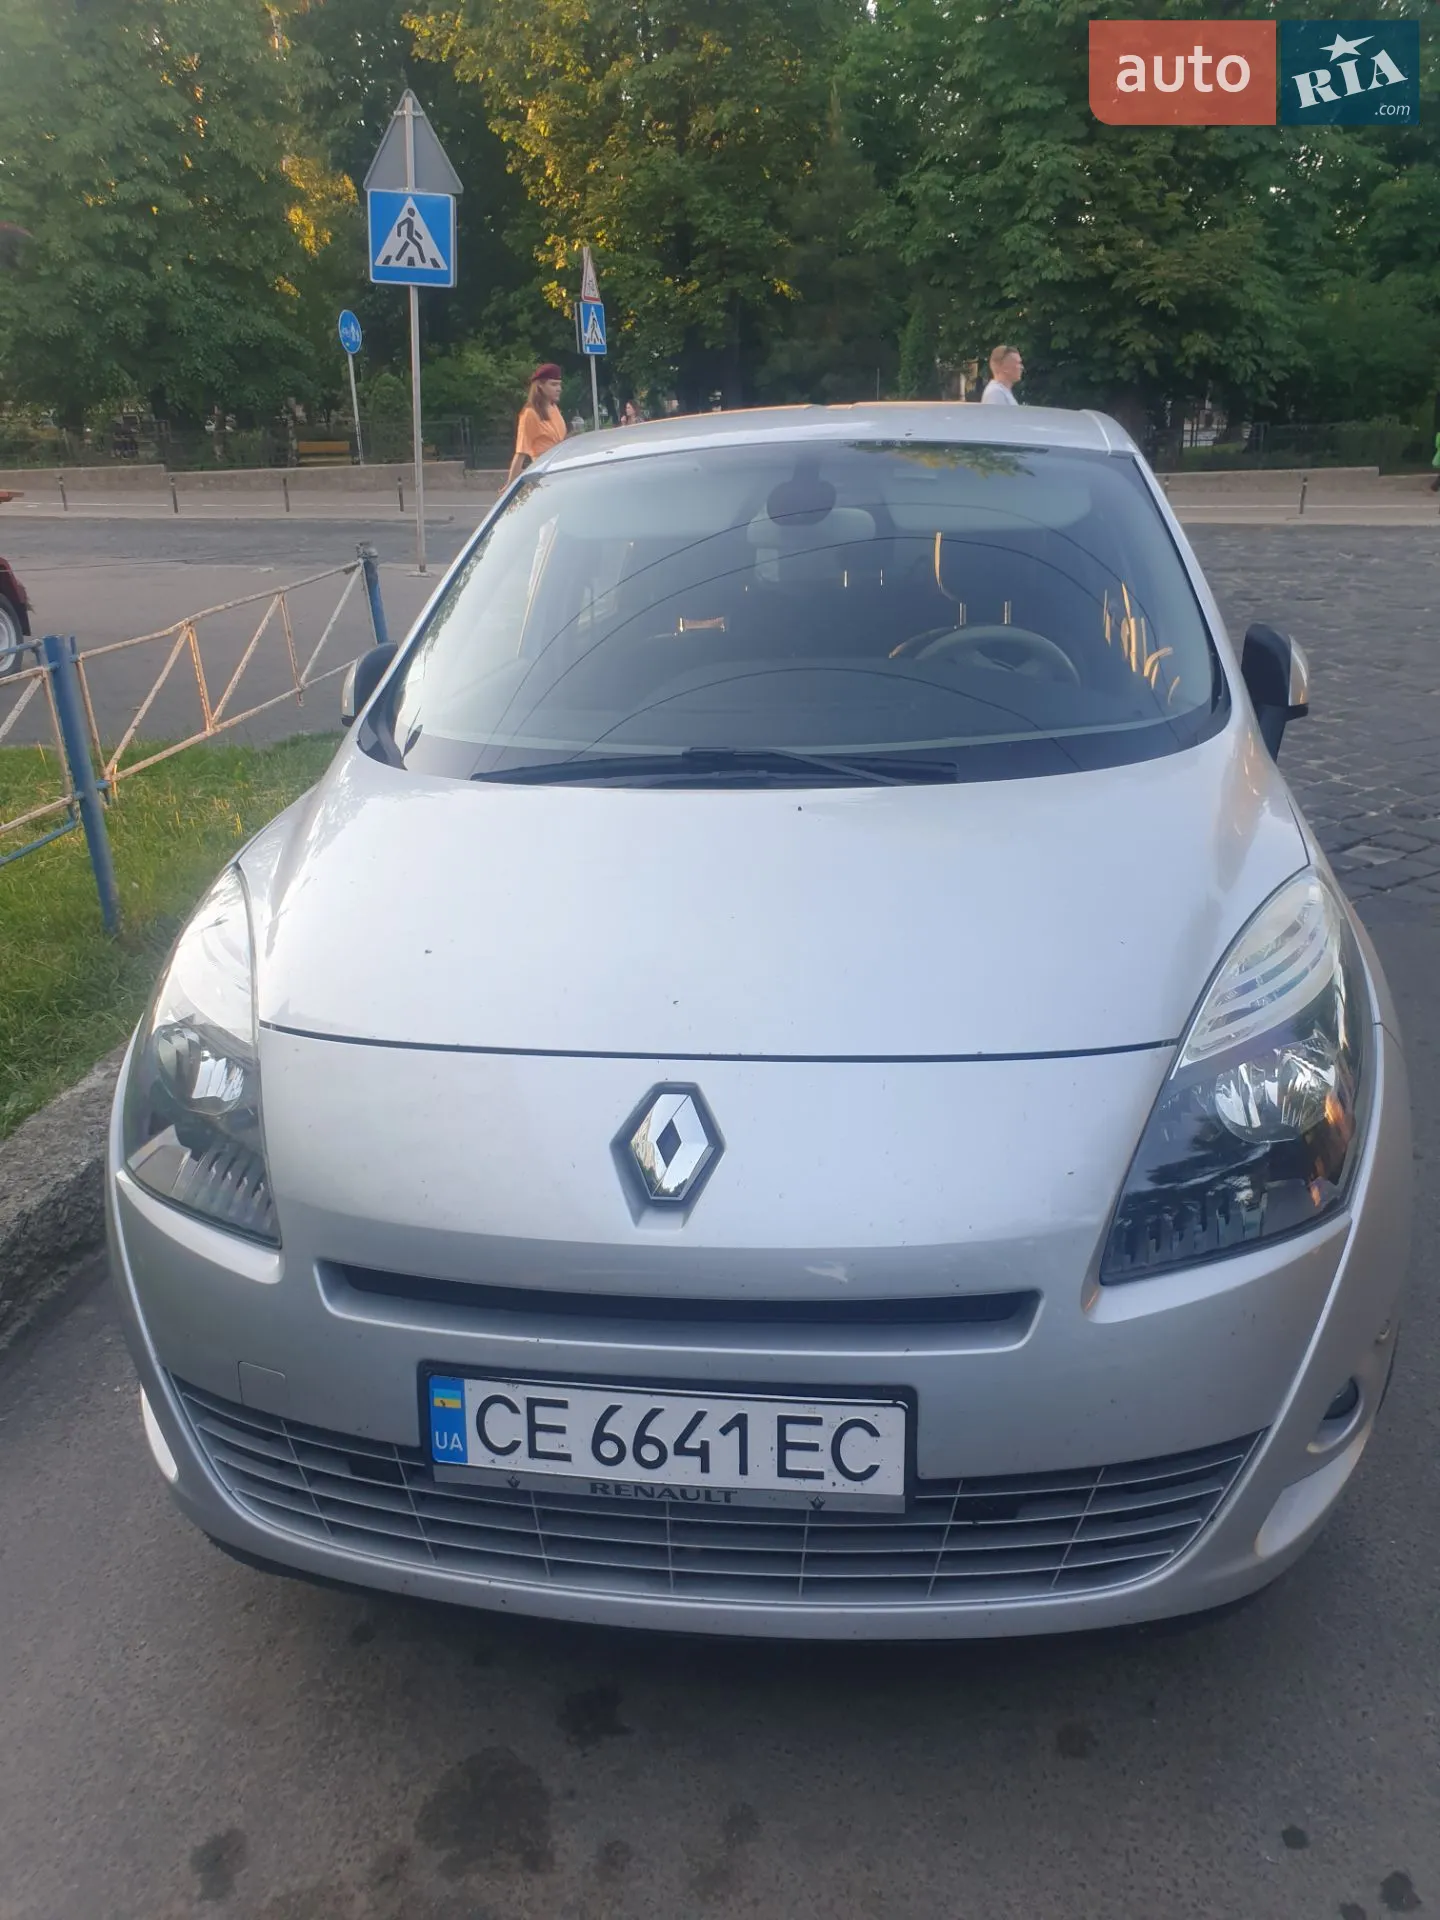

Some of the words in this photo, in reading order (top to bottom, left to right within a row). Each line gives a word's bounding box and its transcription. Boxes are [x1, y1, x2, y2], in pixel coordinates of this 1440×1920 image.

[435, 1431, 464, 1452] UA
[475, 1394, 572, 1462] CE
[590, 1404, 749, 1476] 6641
[776, 1414, 881, 1481] EC
[589, 1482, 738, 1504] RENAULT
